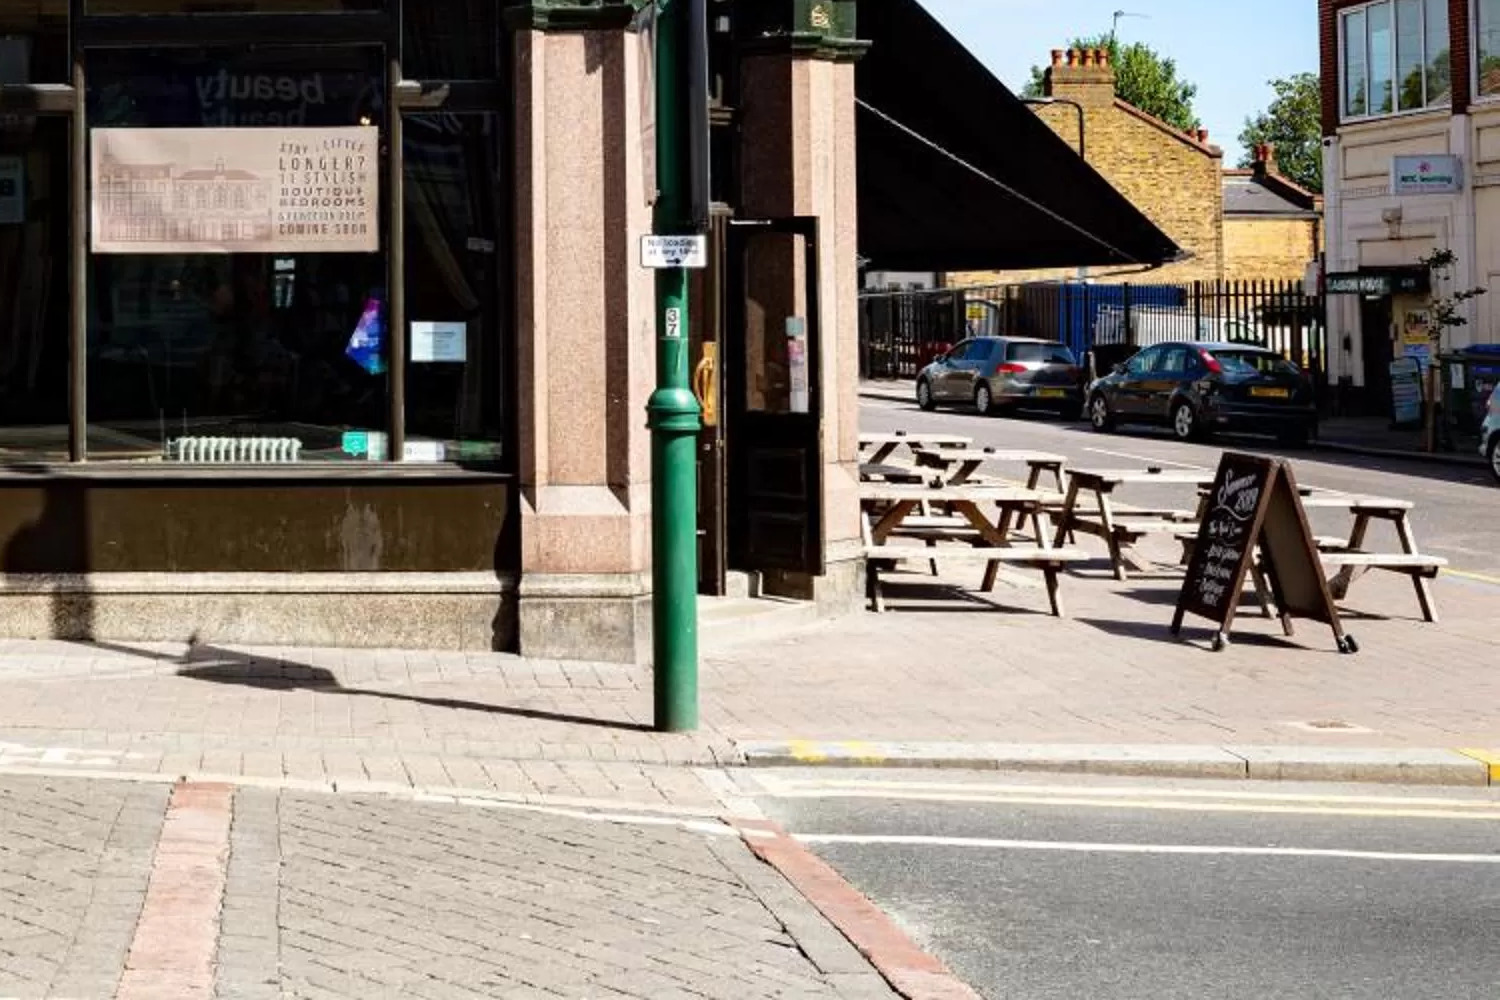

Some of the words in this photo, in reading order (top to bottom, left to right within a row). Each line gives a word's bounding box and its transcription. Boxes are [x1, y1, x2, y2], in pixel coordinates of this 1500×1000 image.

[278, 155, 366, 171] LONGER?
[303, 171, 367, 185] STYLISH
[280, 186, 363, 197] BOUTIQUE
[278, 197, 366, 207] BEDROOMS
